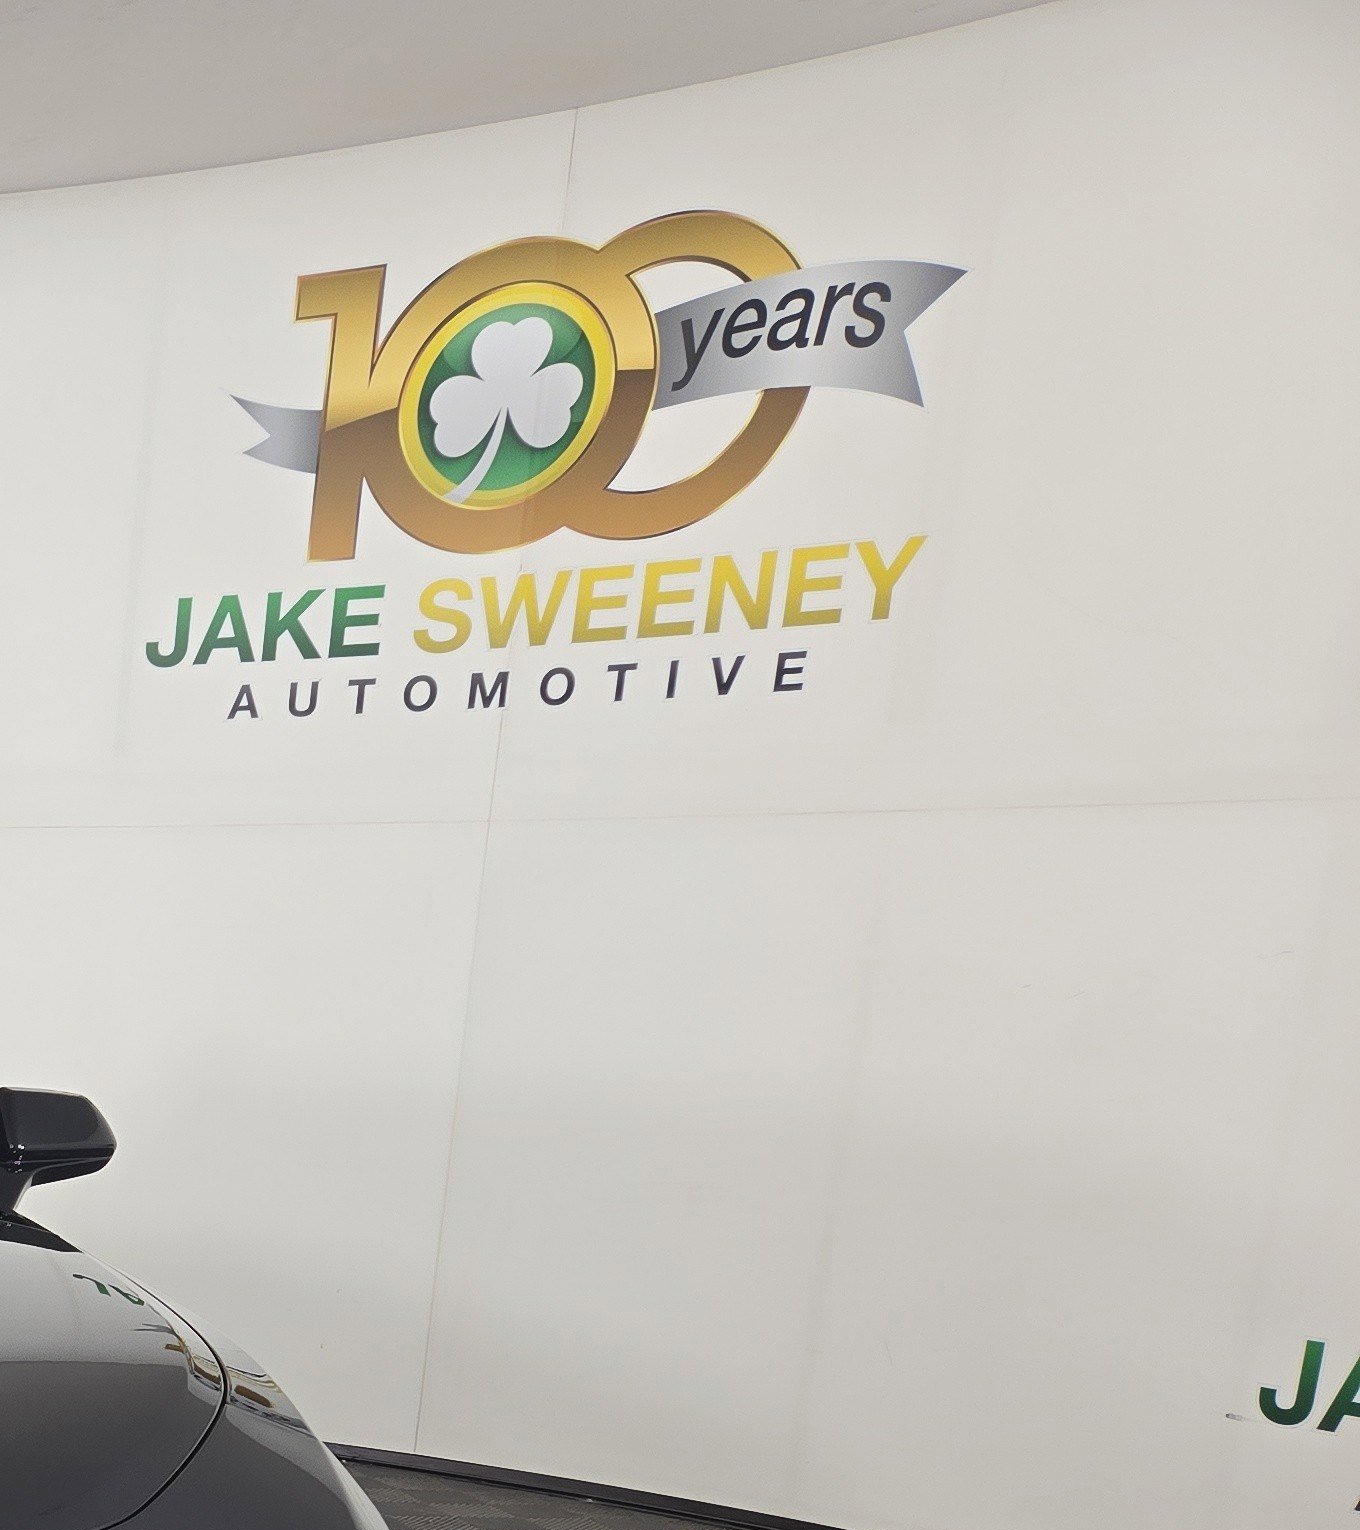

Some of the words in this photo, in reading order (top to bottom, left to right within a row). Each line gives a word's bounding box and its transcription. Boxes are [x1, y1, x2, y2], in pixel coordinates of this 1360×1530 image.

[673, 281, 893, 391] years
[145, 585, 387, 669] JAKE
[413, 535, 928, 655] SWEENEY
[227, 651, 808, 720] AUTOMOTIVE
